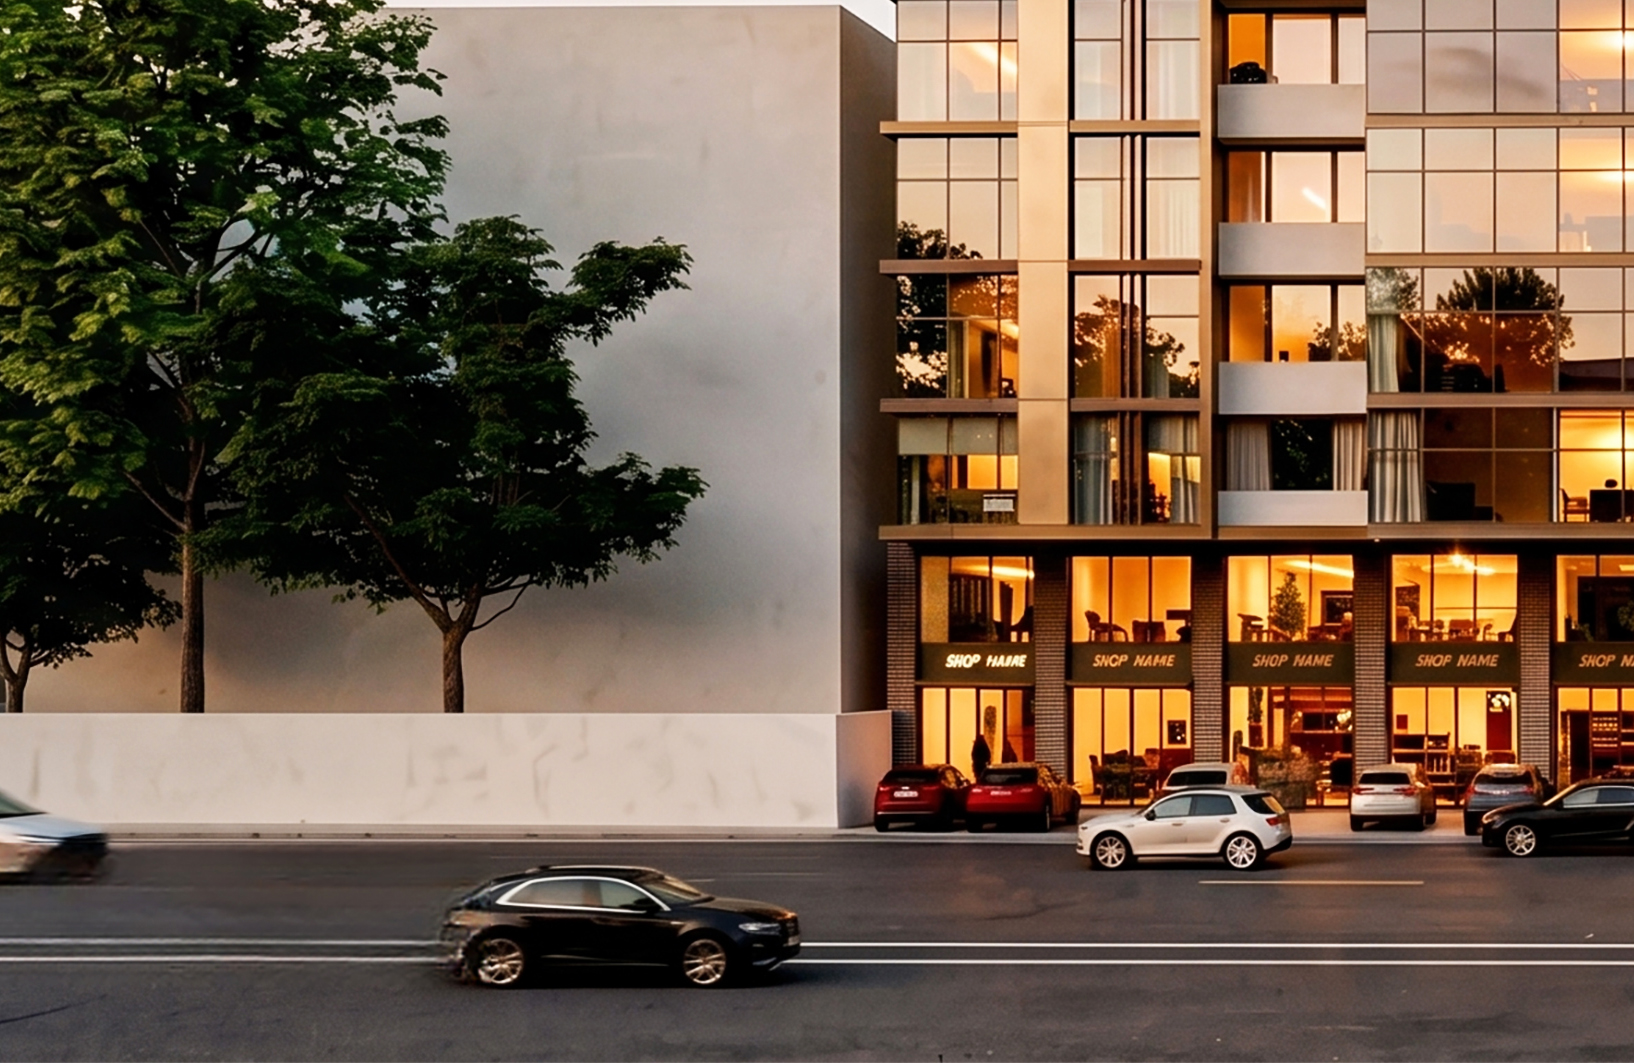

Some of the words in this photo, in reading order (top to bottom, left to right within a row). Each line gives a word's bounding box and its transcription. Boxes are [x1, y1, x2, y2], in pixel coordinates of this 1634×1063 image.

[945, 654, 981, 668] SHOP
[1133, 654, 1175, 667] NAME
[1253, 654, 1288, 667] SHOP
[1415, 654, 1452, 667] SHOP
[1457, 654, 1499, 667] NAME
[1579, 654, 1616, 667] SHOP
